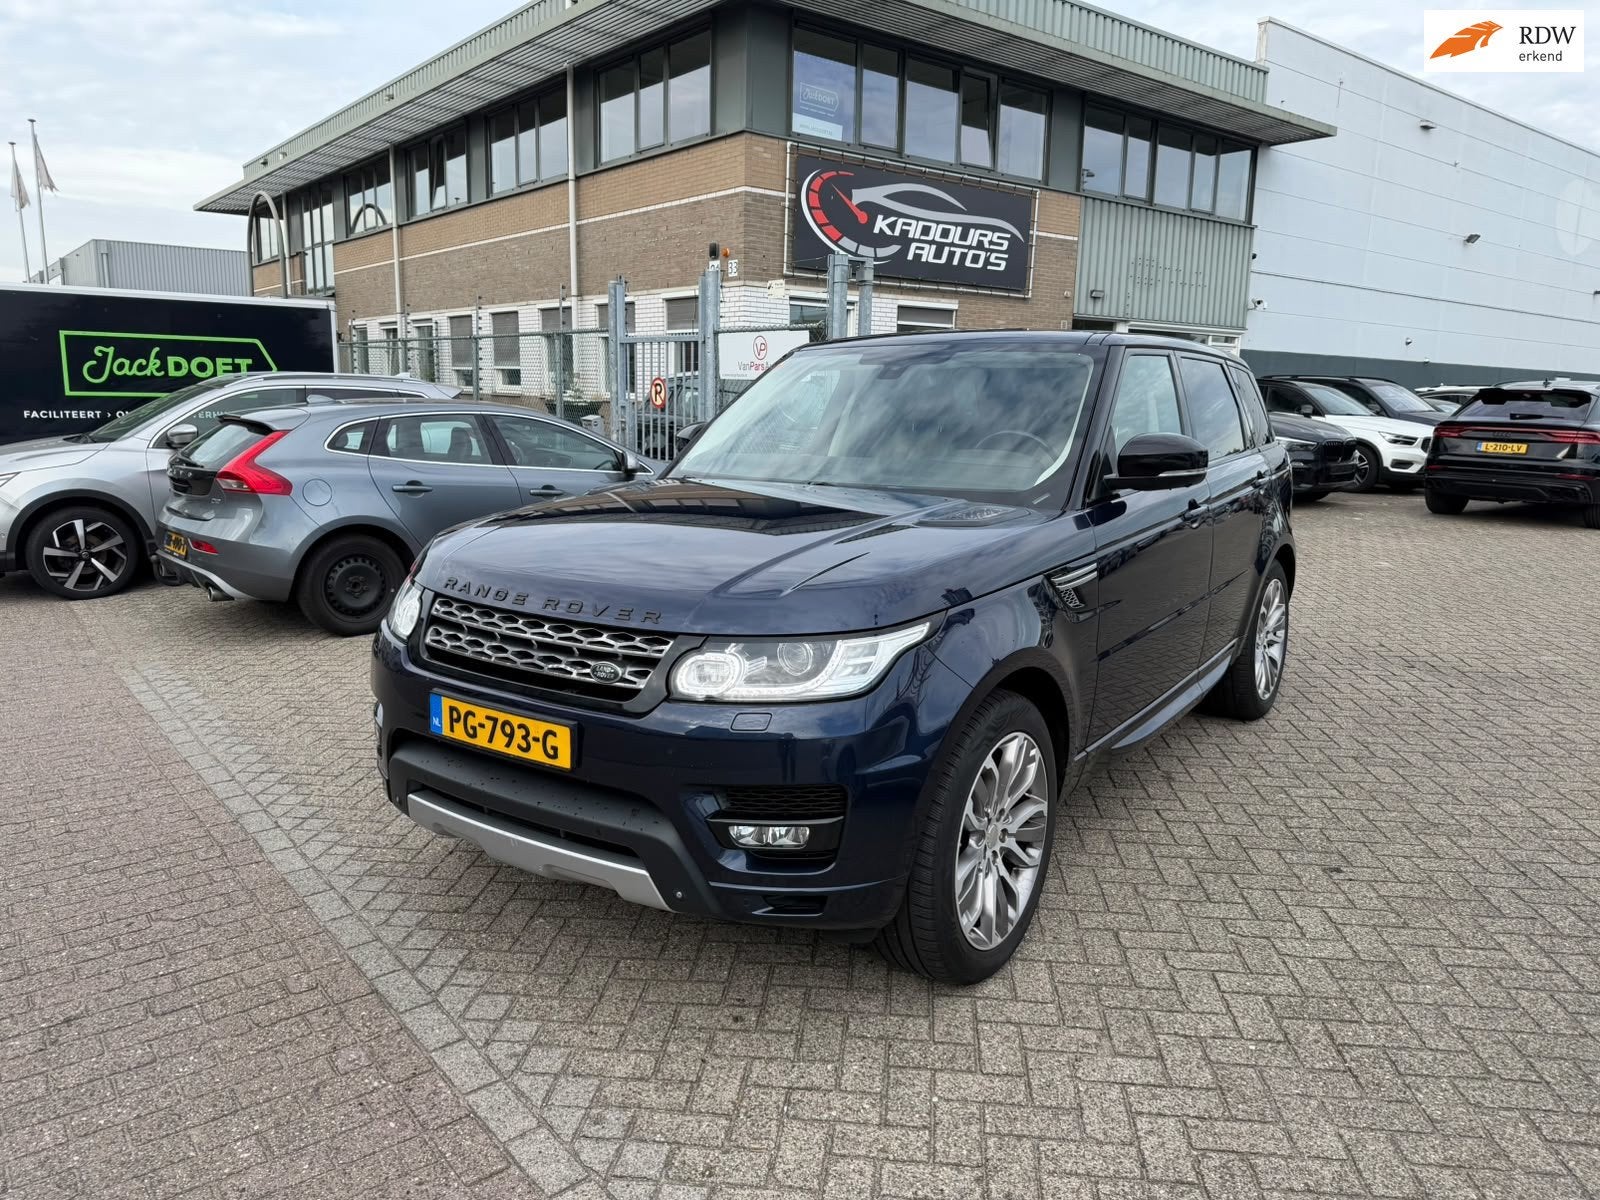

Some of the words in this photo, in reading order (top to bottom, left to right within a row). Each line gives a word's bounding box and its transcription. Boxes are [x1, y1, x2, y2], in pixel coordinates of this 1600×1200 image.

[873, 214, 1012, 251] KADOURS
[906, 242, 1009, 271] AUTO'S
[23, 410, 102, 419] FACILITEERT
[443, 576, 530, 606] RANGE
[541, 597, 662, 625] ROVER
[432, 716, 441, 727] NL
[448, 705, 560, 760] PG-793-G
